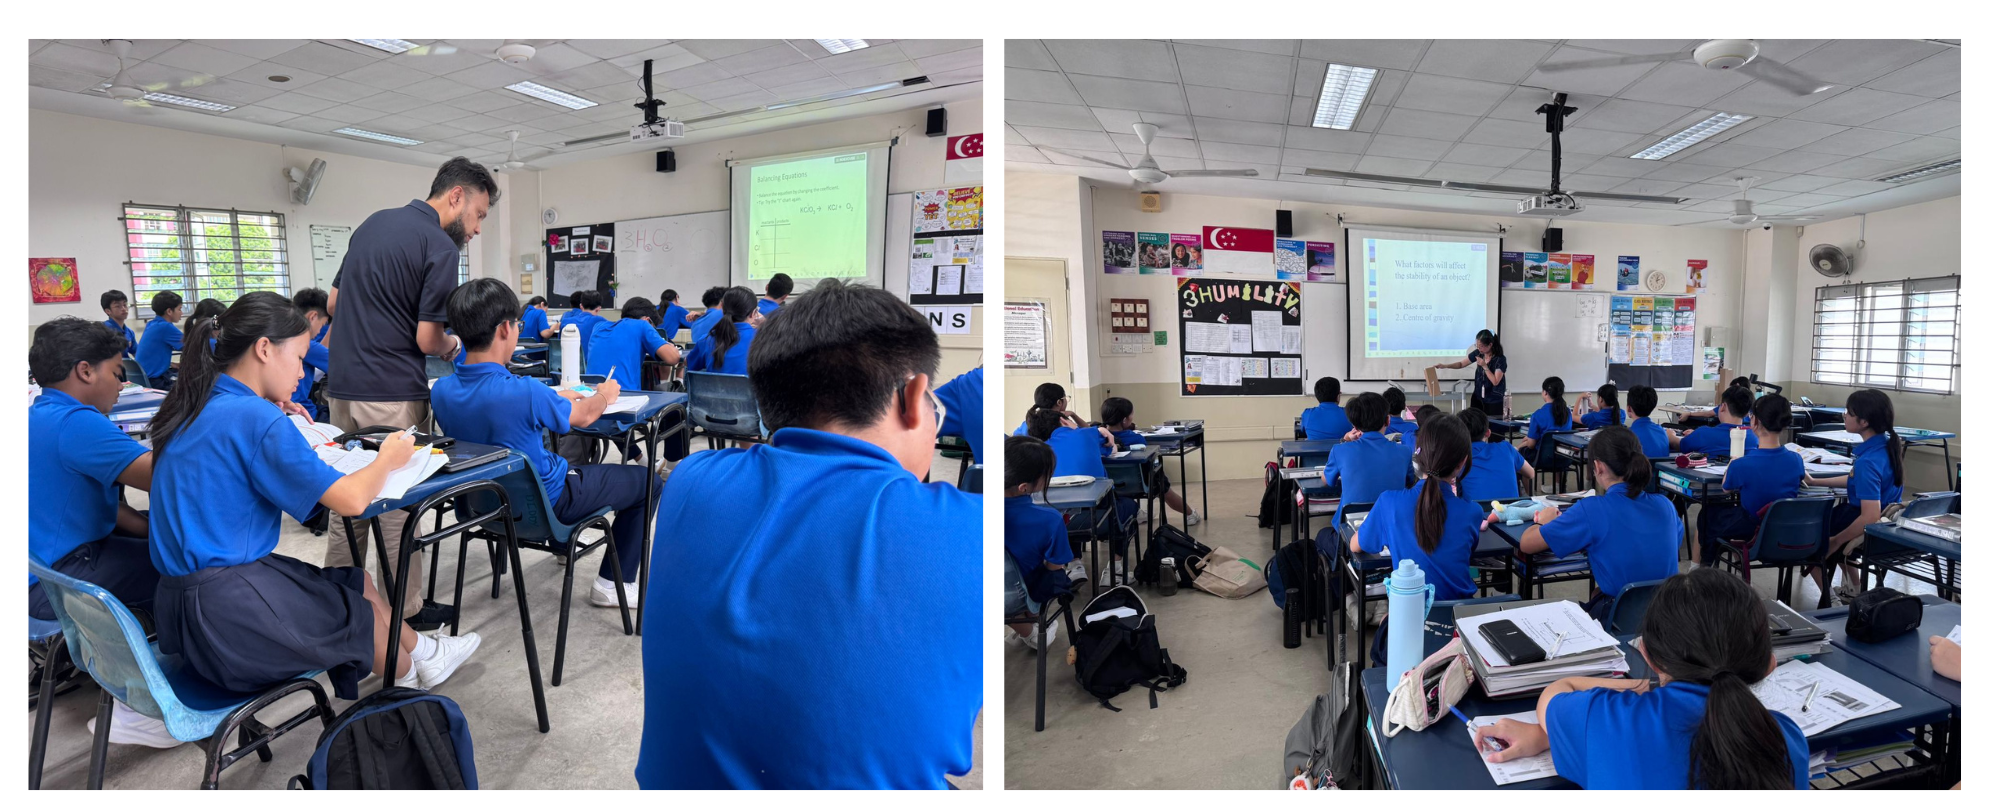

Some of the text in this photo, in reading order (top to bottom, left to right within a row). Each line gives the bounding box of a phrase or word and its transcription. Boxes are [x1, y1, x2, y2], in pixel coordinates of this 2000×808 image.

[757, 172, 808, 183] Balancing Equations
[1395, 260, 1466, 270] What factors will affect
[1395, 272, 1405, 280] the
[1406, 272, 1431, 281] stability
[1449, 273, 1471, 282] object?
[1396, 302, 1402, 310] 1.
[1403, 302, 1418, 310] Base
[1403, 313, 1424, 321] Centre
[1433, 314, 1455, 323] gravity
